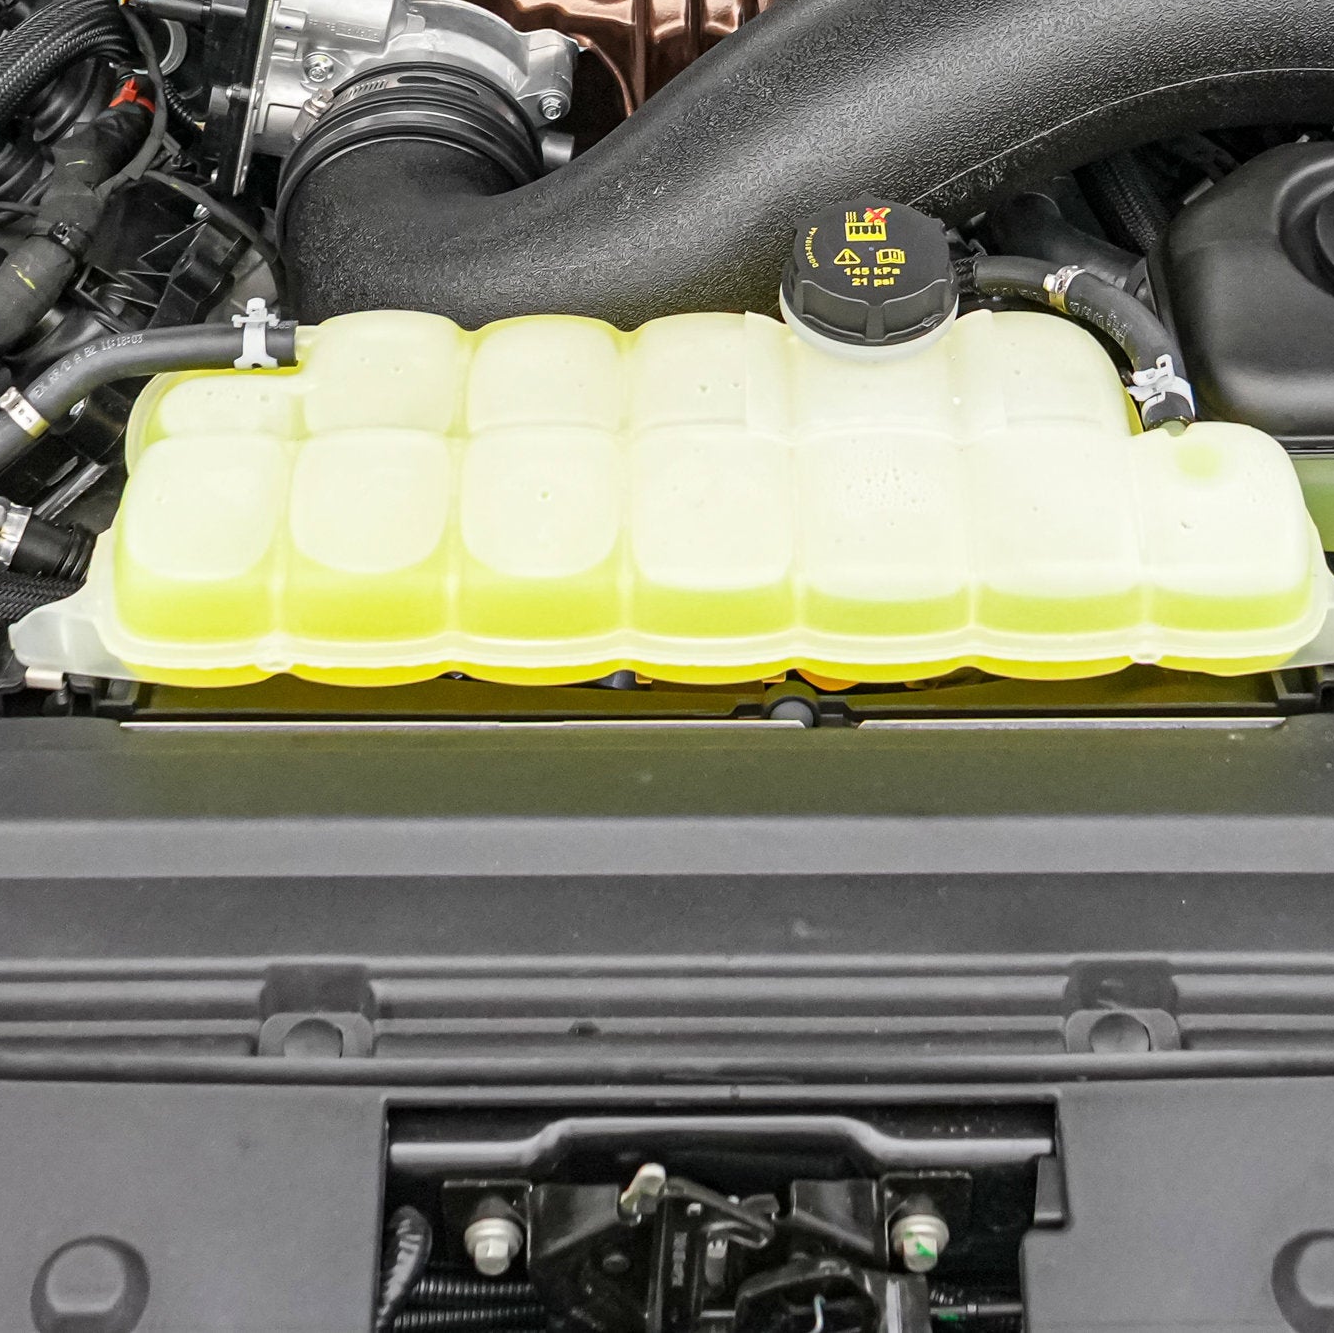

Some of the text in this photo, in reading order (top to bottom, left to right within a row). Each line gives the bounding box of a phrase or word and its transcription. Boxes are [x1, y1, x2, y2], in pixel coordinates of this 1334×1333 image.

[843, 267, 901, 276] 145 kPa
[851, 276, 895, 287] 21 psi
